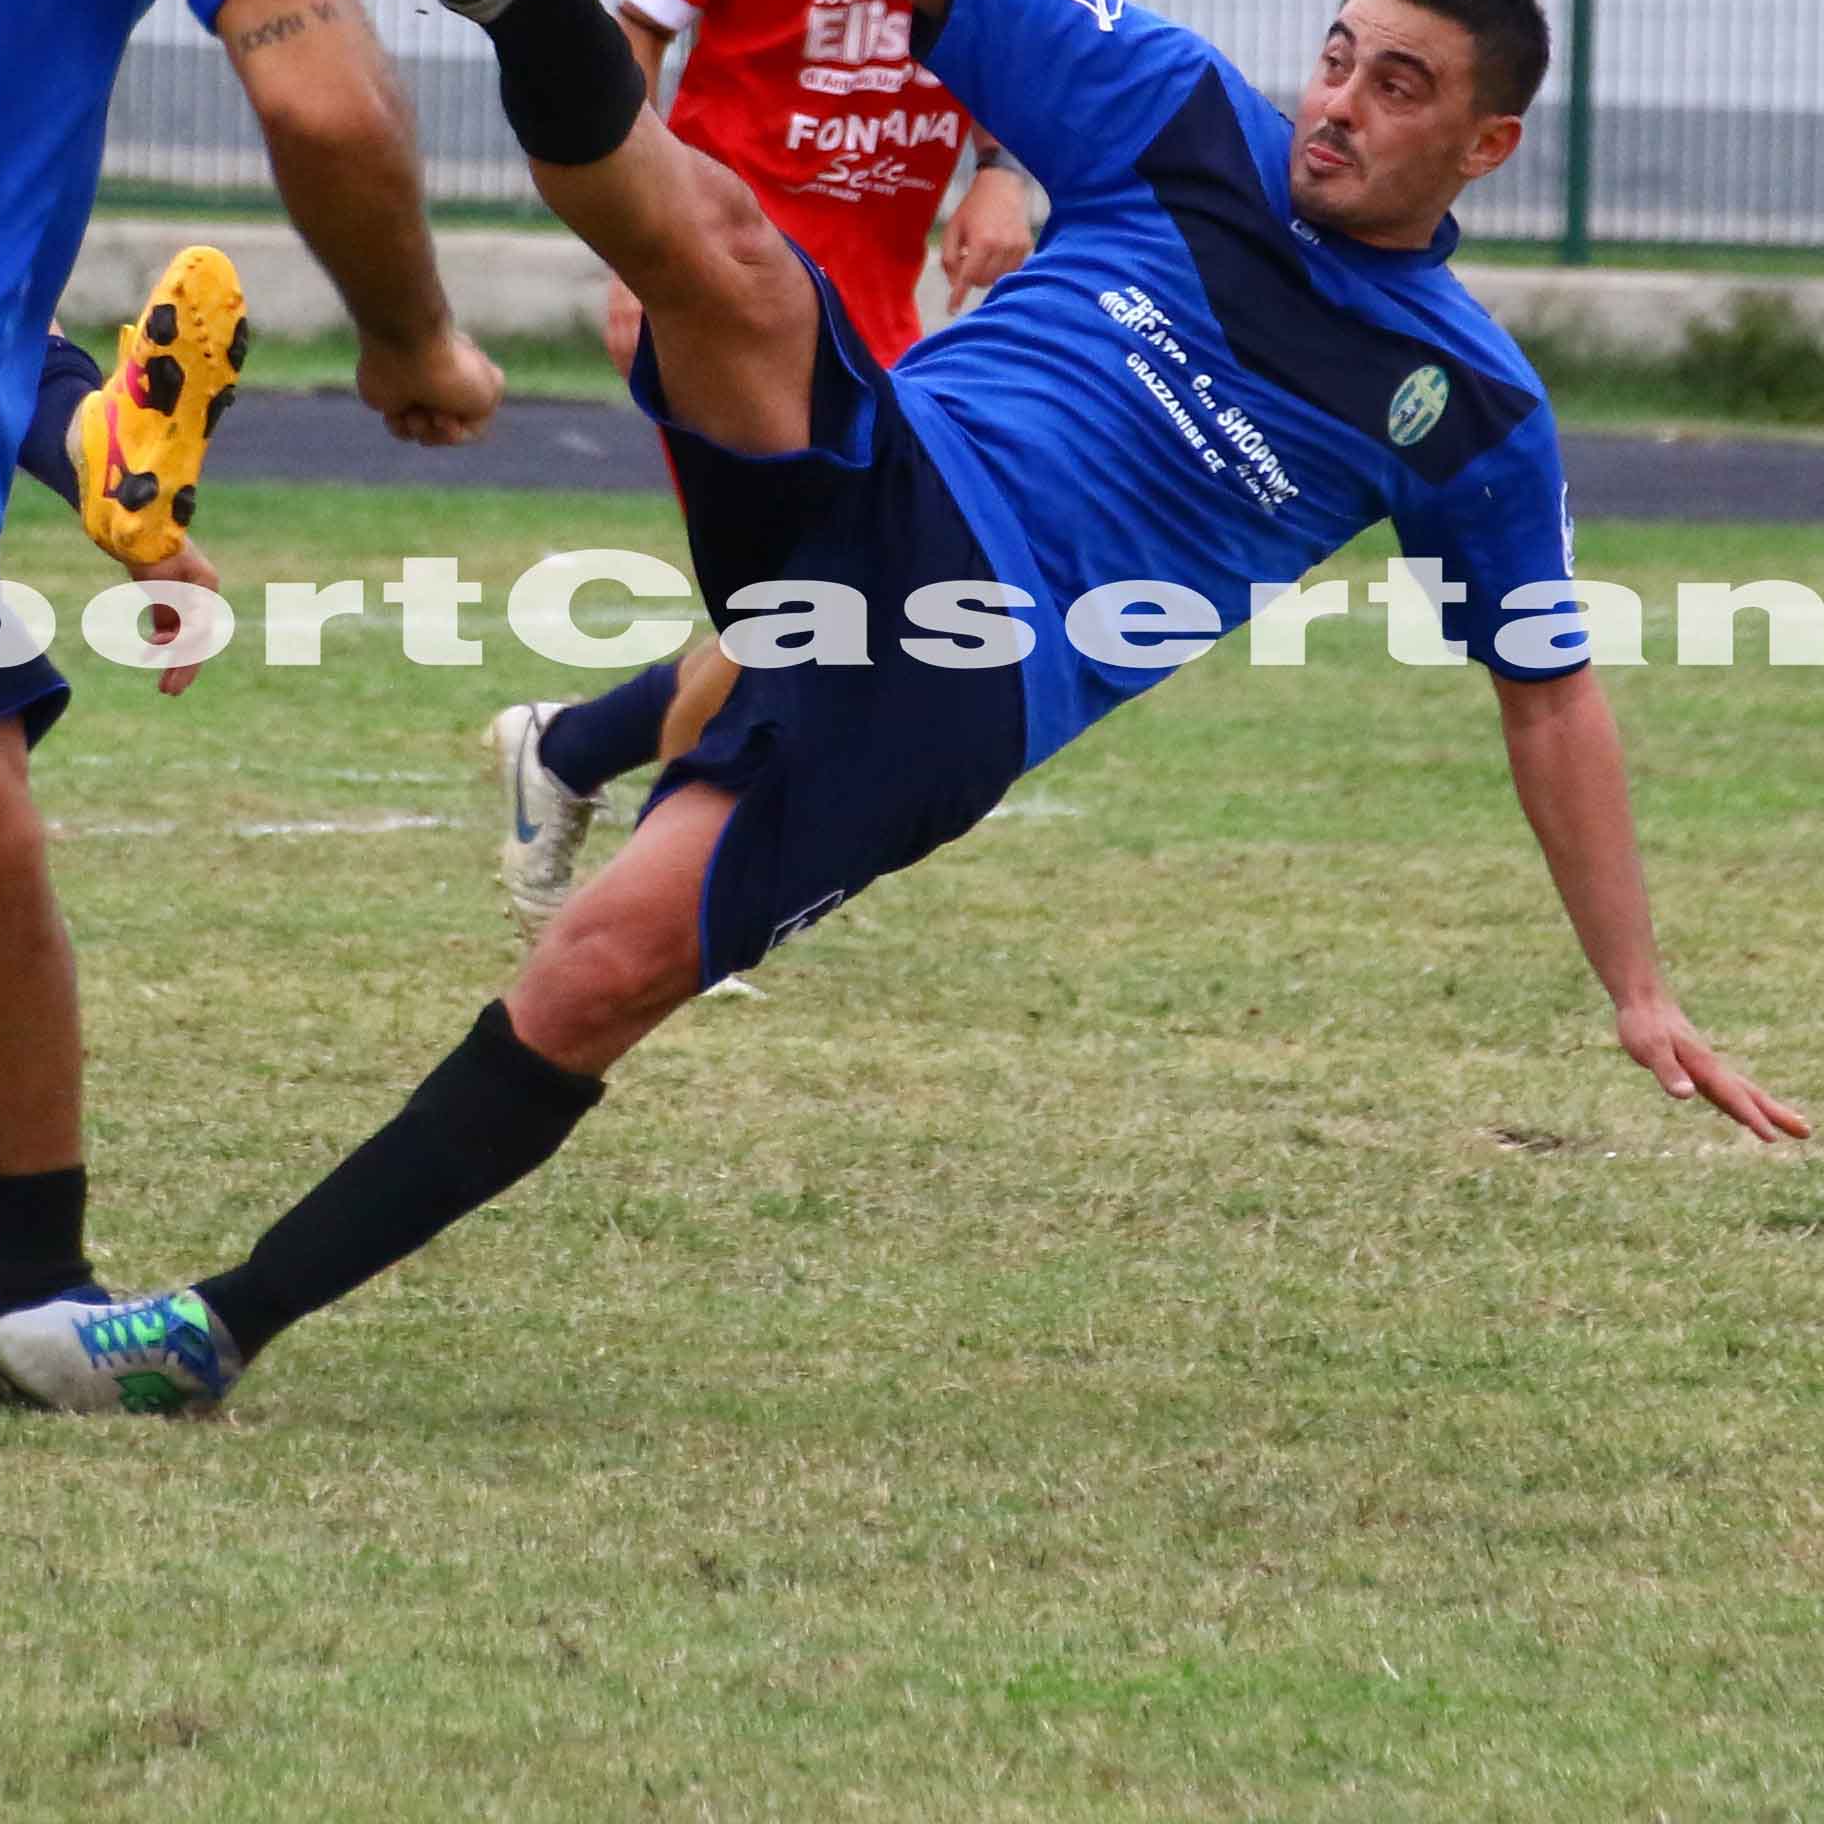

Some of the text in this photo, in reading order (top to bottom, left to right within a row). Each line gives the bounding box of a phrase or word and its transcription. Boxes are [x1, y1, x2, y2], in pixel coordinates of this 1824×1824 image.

[1126, 352, 1227, 474] GRAZZANISE CE
[1216, 406, 1300, 504] SHOPPING
